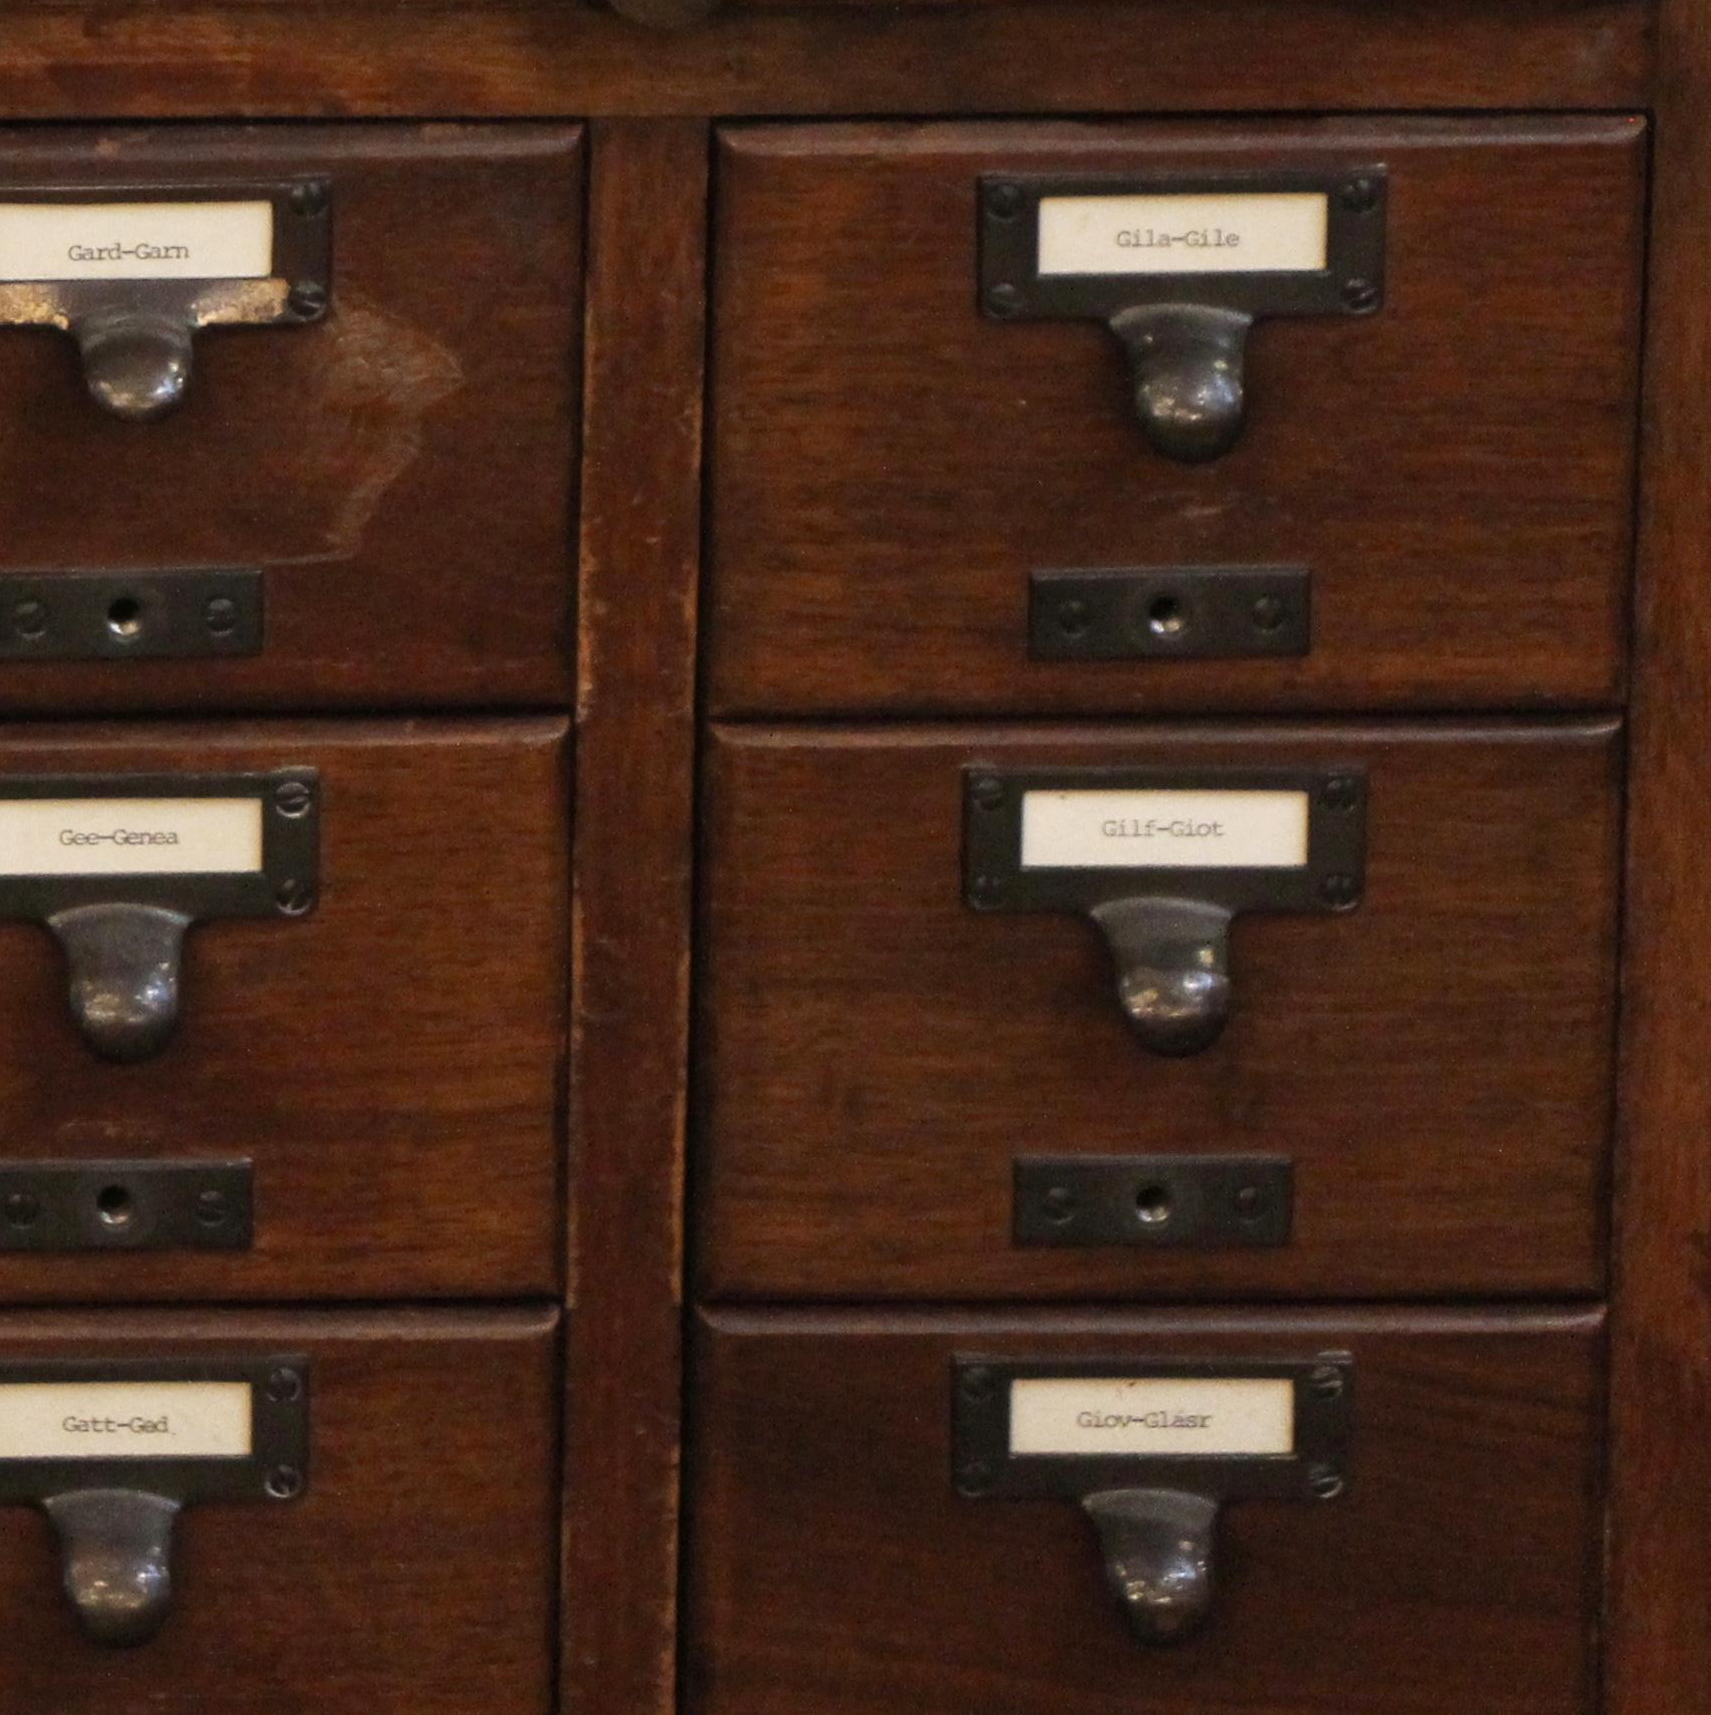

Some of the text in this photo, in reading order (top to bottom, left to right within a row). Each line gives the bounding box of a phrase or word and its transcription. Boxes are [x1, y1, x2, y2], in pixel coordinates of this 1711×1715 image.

[1115, 228, 1241, 249] Gila-Gile
[67, 242, 190, 262] Gard-Garn
[58, 829, 180, 847] Gee-Genea
[1101, 819, 1225, 838] Gilf-Giot
